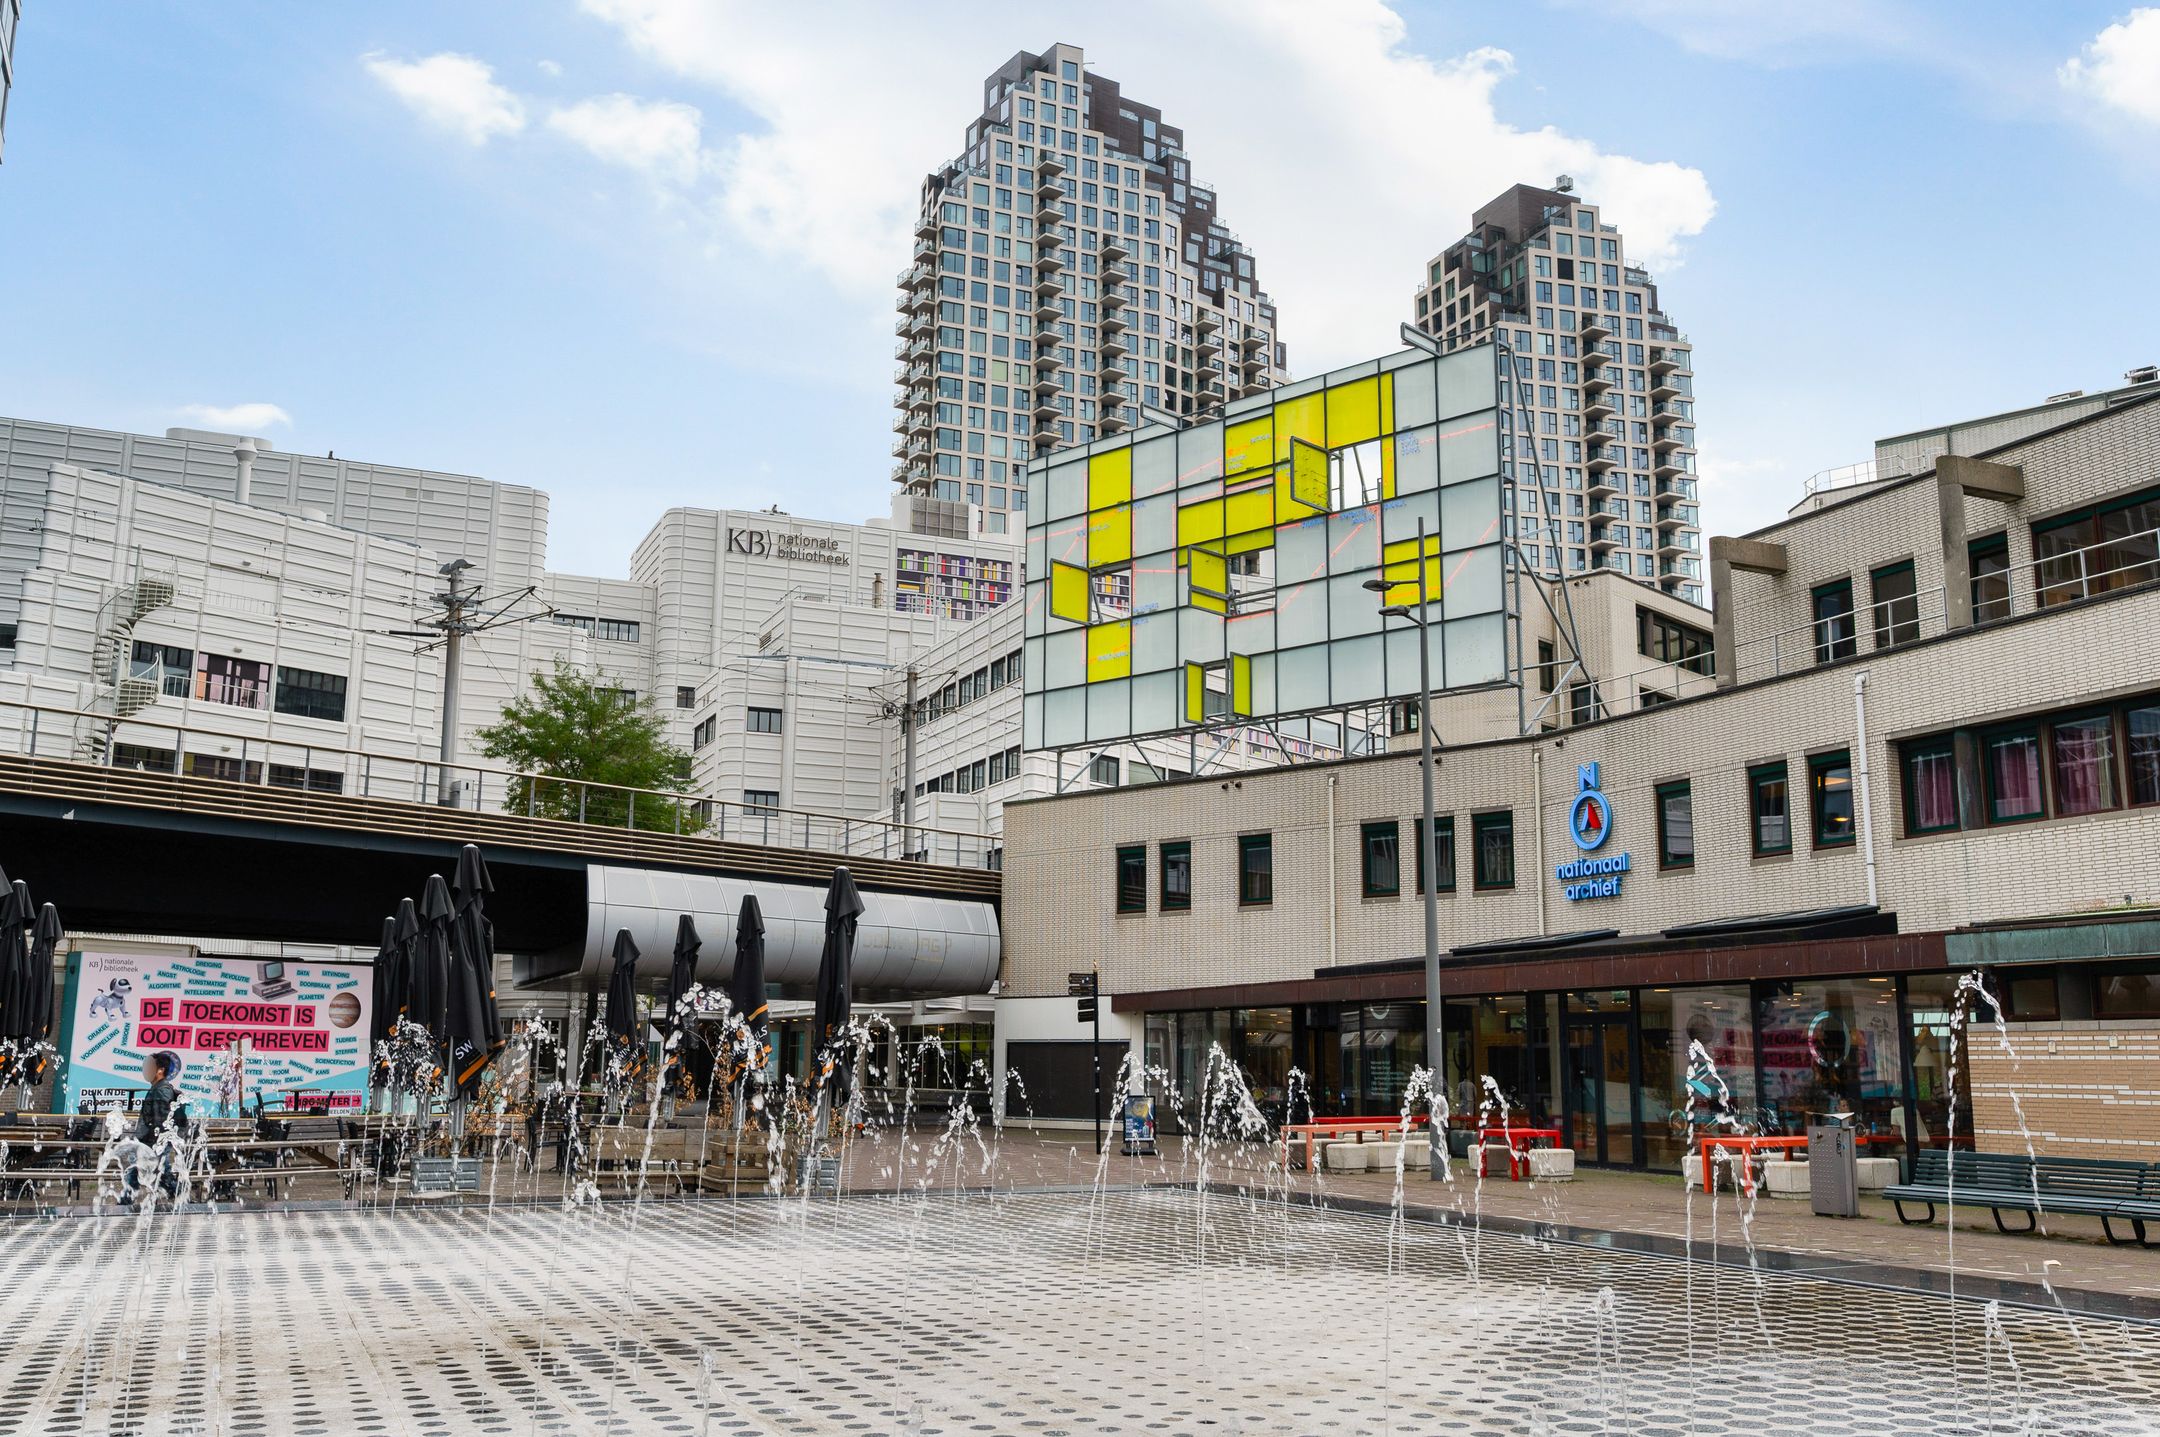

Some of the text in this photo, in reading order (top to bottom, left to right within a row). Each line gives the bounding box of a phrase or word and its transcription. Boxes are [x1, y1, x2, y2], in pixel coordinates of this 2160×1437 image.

[726, 528, 839, 555] KB nationale
[776, 546, 850, 567] bibliotheek
[1556, 852, 1631, 880] nationaal
[1565, 876, 1622, 901] archief
[103, 964, 139, 973] bibliotheek
[104, 958, 134, 966] nationale
[157, 970, 177, 979] ANGST
[188, 978, 227, 987] KUNSTMATIGE
[148, 982, 181, 990] ALGORITME
[143, 1001, 313, 1024] DE TOEKOMST IS
[87, 1022, 110, 1041] ORAKEL
[140, 1027, 190, 1046] OOIT
[80, 1028, 120, 1060] VOORSPELLING
[81, 1089, 103, 1097] DUIK
